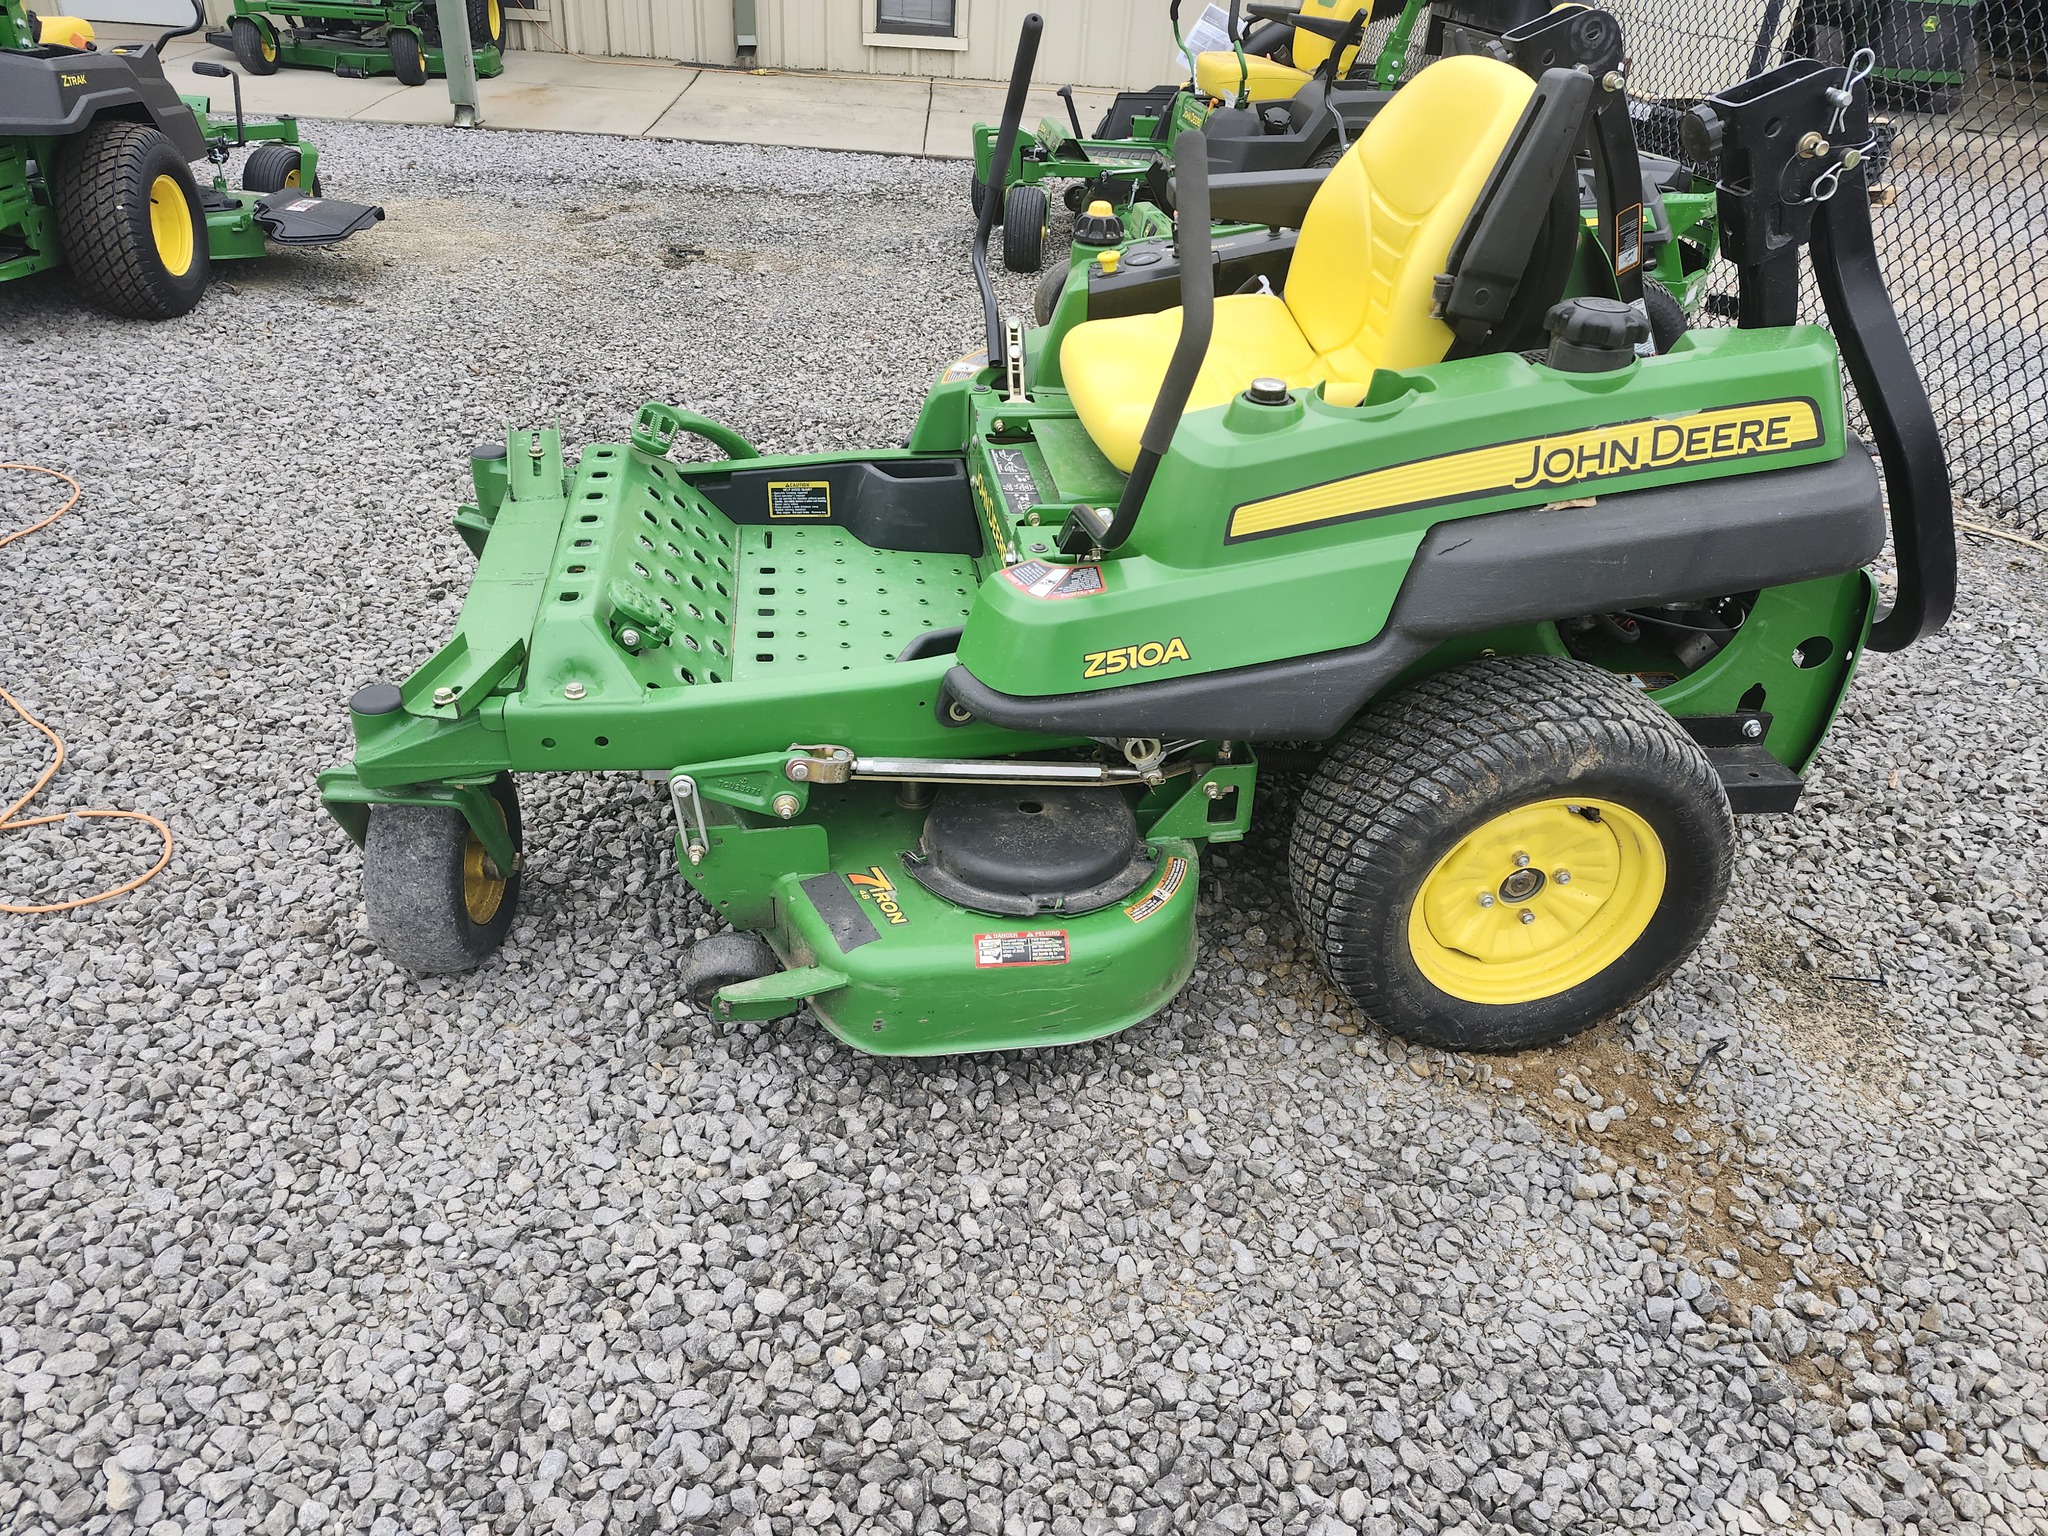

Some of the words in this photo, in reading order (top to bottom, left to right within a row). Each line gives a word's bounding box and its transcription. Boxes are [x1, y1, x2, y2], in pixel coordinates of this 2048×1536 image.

[61, 74, 87, 87] ZTRAK
[1513, 436, 1640, 485] JOHN
[1650, 415, 1792, 462] DEERE
[1083, 637, 1191, 678] Z510A
